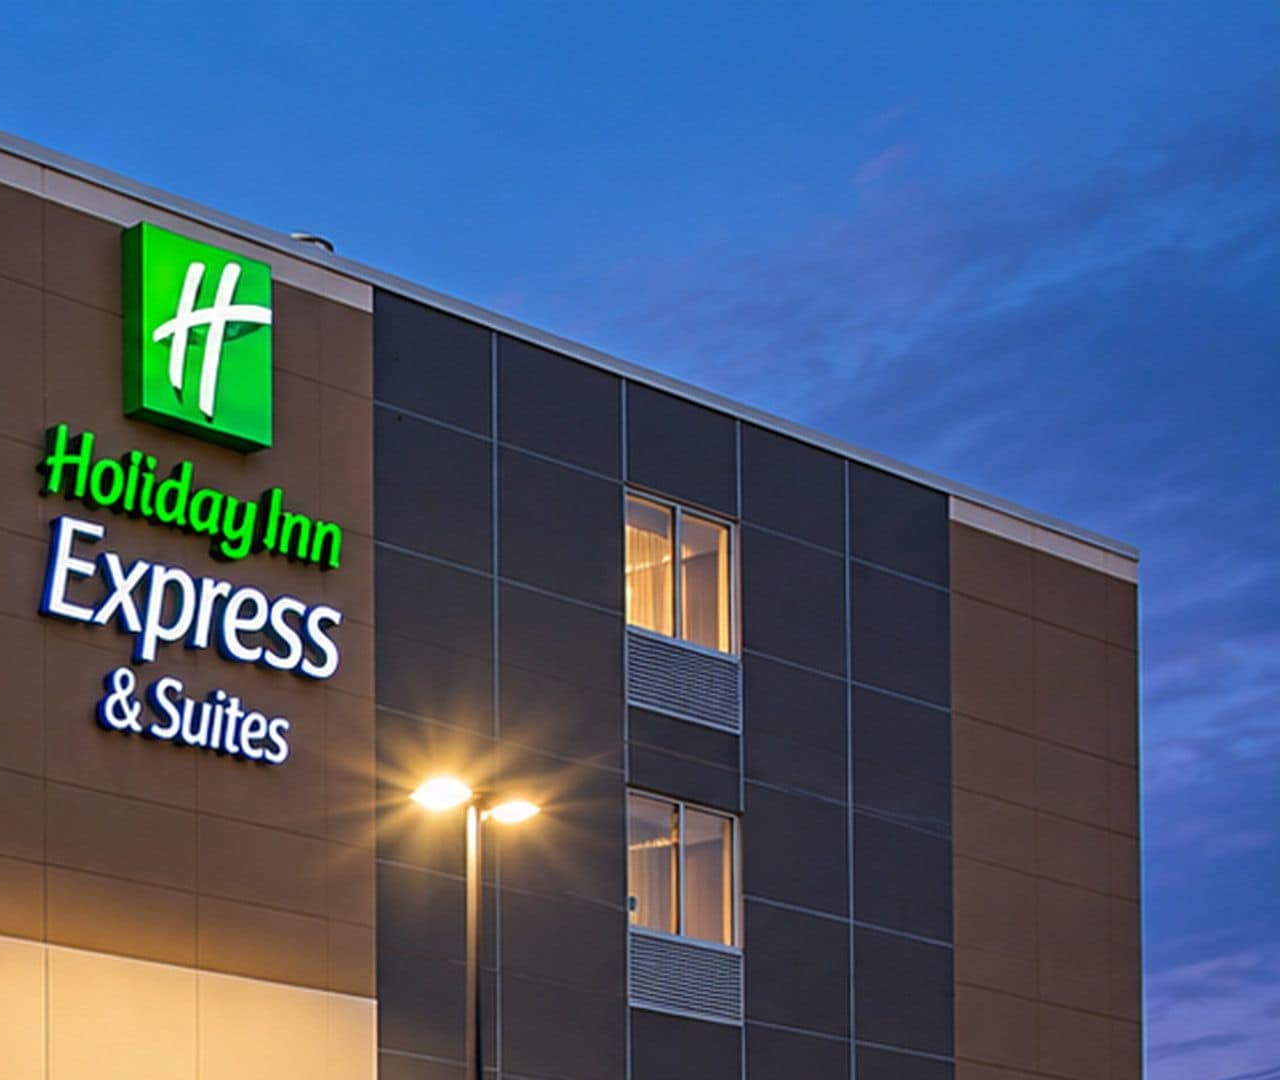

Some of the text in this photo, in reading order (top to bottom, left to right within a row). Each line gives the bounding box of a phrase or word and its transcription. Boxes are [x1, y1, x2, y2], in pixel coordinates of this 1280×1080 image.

[262, 487, 343, 569] Inn
[48, 516, 342, 679] Express
[104, 666, 290, 764] & Suites
